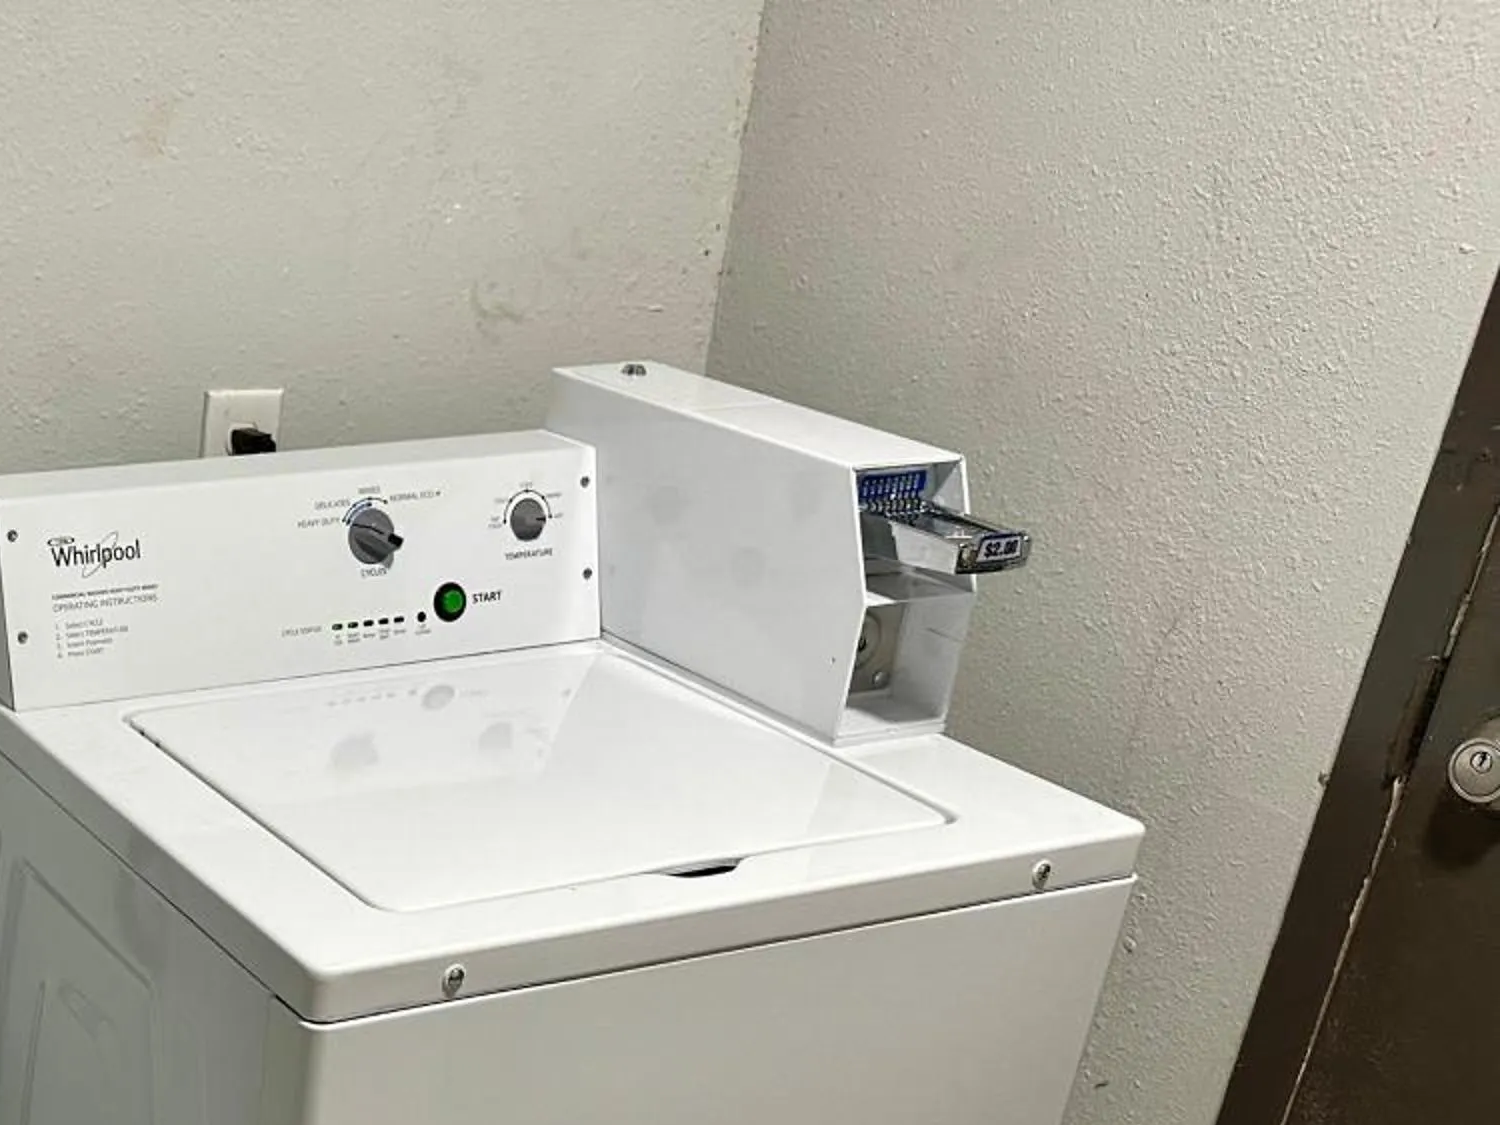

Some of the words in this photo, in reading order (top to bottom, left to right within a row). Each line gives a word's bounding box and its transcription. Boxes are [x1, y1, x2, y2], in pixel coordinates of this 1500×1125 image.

[51, 538, 142, 569] Whirlpool
[504, 547, 553, 561] TEMPERATURE
[983, 539, 1019, 559] $2.00
[472, 589, 503, 605] START
